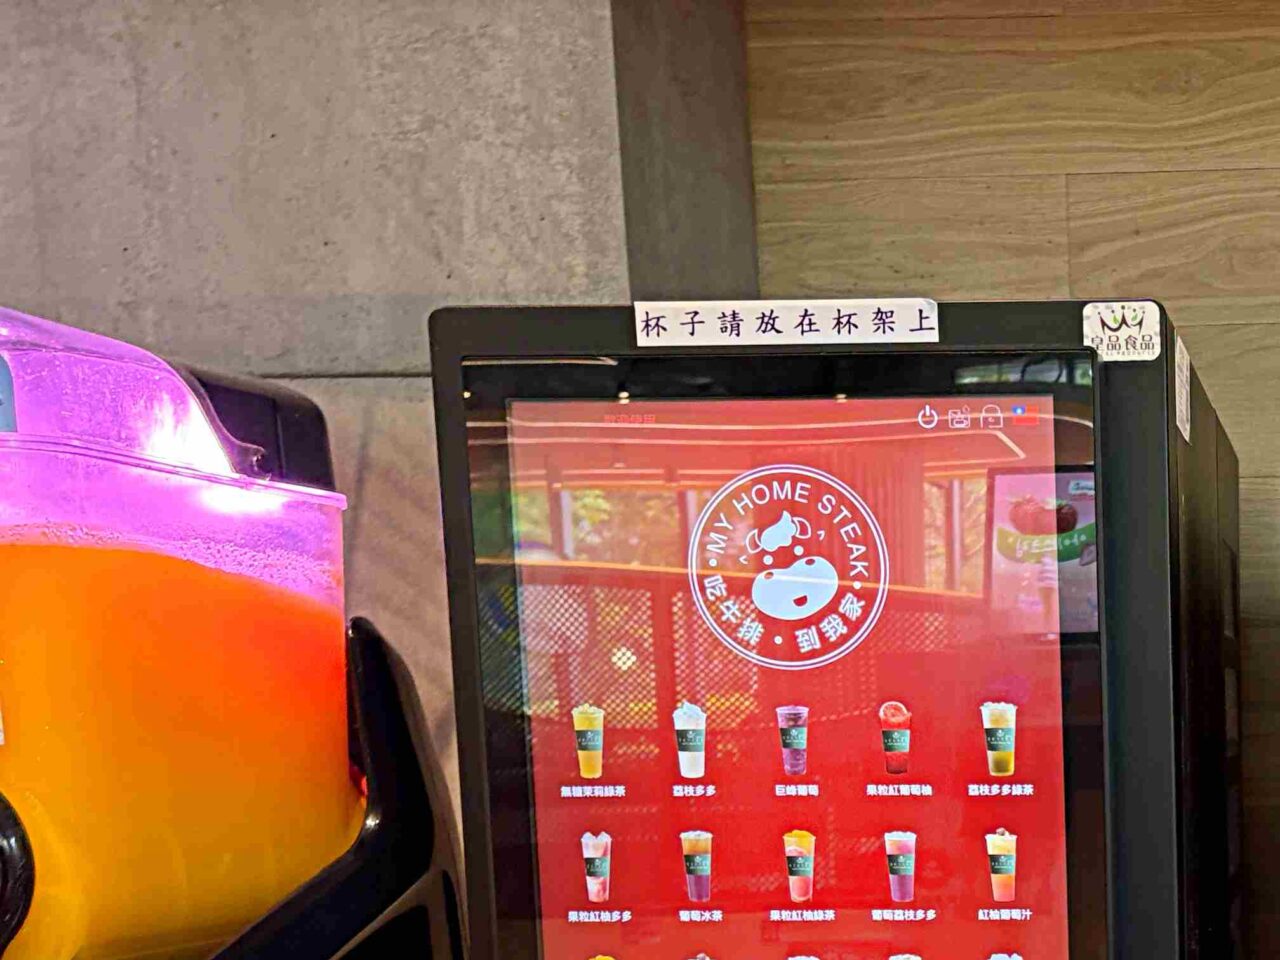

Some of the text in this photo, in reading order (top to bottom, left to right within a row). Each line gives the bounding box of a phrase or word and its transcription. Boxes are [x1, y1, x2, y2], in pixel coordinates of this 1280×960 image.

[640, 307, 936, 338] 杯子請放在杯架上
[706, 480, 869, 578] MY HOME STEAK
[703, 574, 866, 653] 吃牛排 到我家
